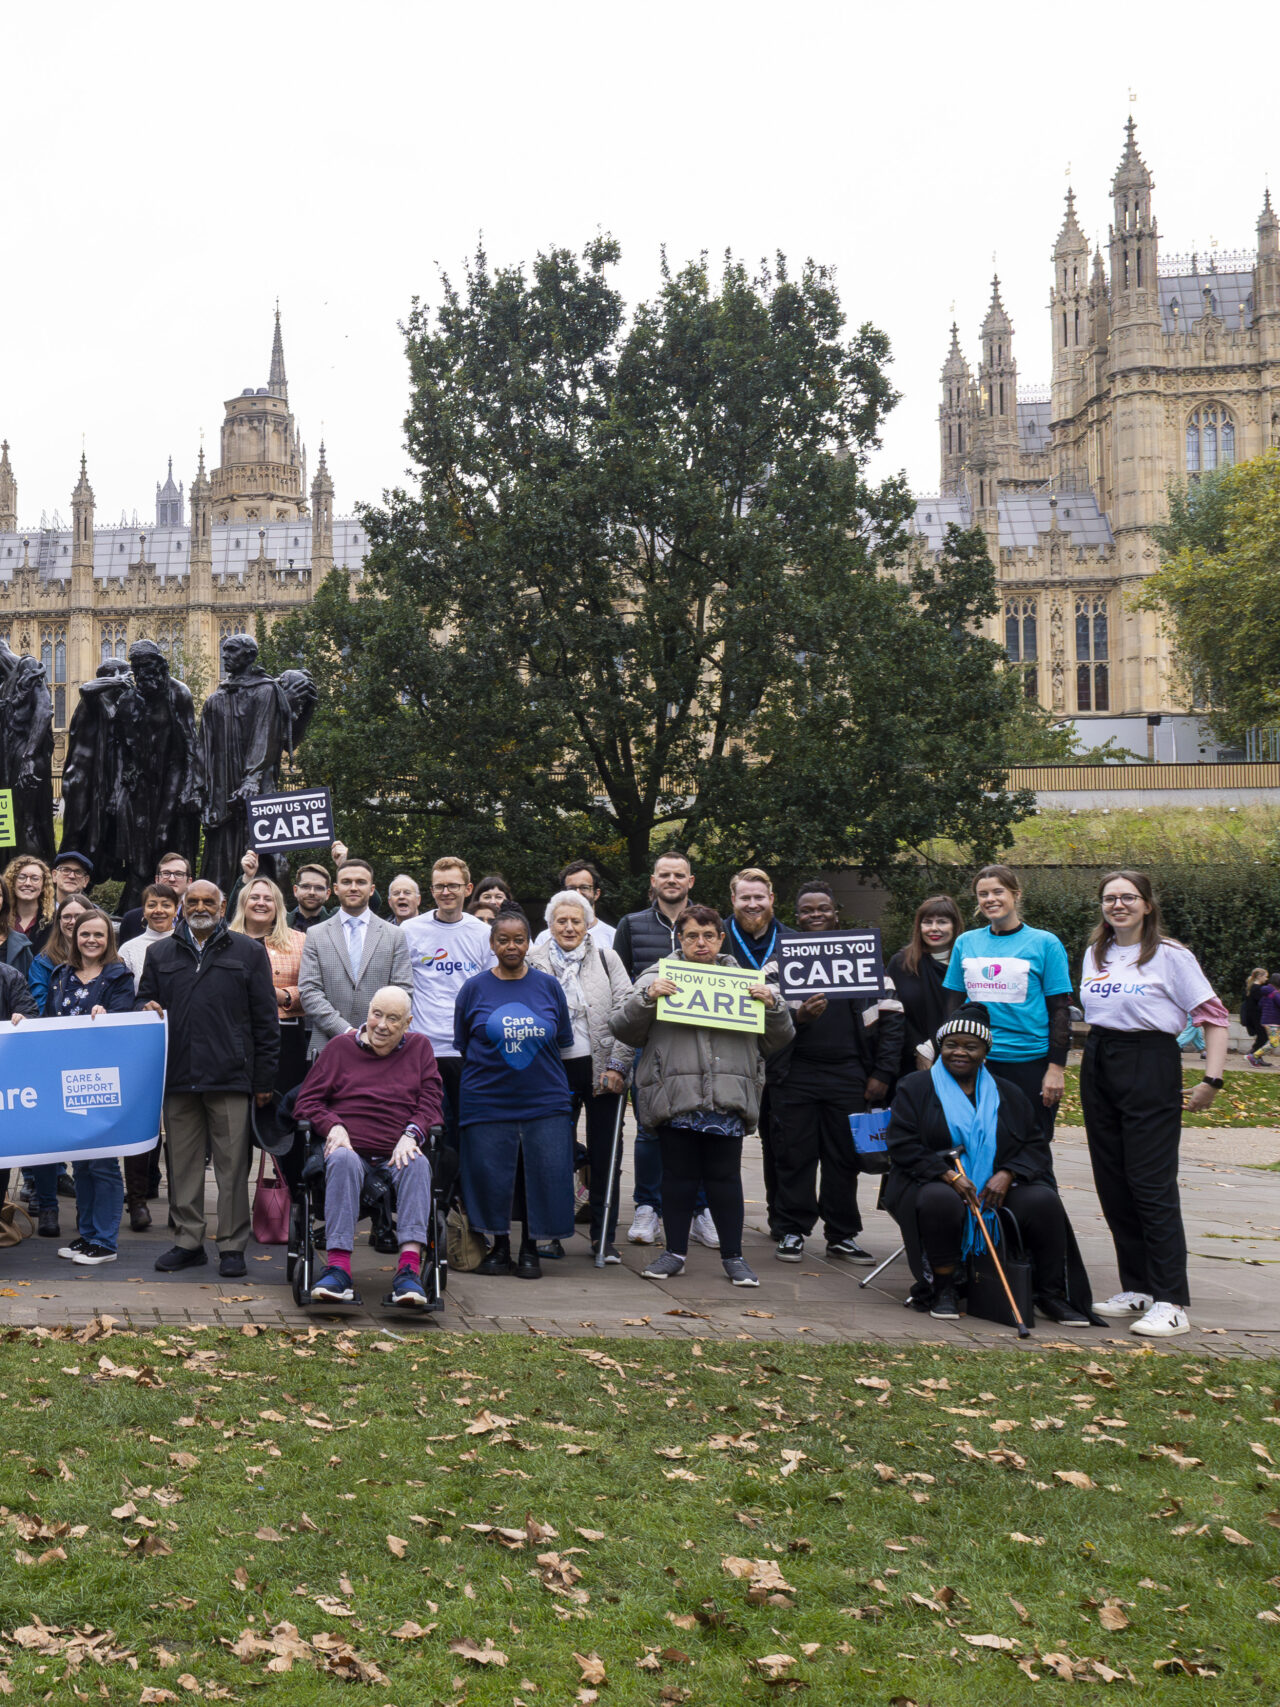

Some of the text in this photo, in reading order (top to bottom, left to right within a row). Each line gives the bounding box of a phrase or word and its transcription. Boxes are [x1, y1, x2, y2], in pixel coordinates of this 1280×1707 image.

[251, 799, 326, 817] SHOW US YOU
[253, 812, 329, 841] CARE
[782, 942, 875, 957] SHOW US YOU
[783, 958, 878, 986] CARE
[665, 971, 752, 990] SHOW US YO
[664, 986, 758, 1018] CARE
[502, 1016, 534, 1026] Care
[503, 1025, 546, 1040] Rights
[505, 1041, 522, 1054] UK
[65, 1073, 102, 1083] CARE &
[66, 1082, 113, 1094] SUPPORT
[67, 1094, 118, 1106] ALLIANCE
